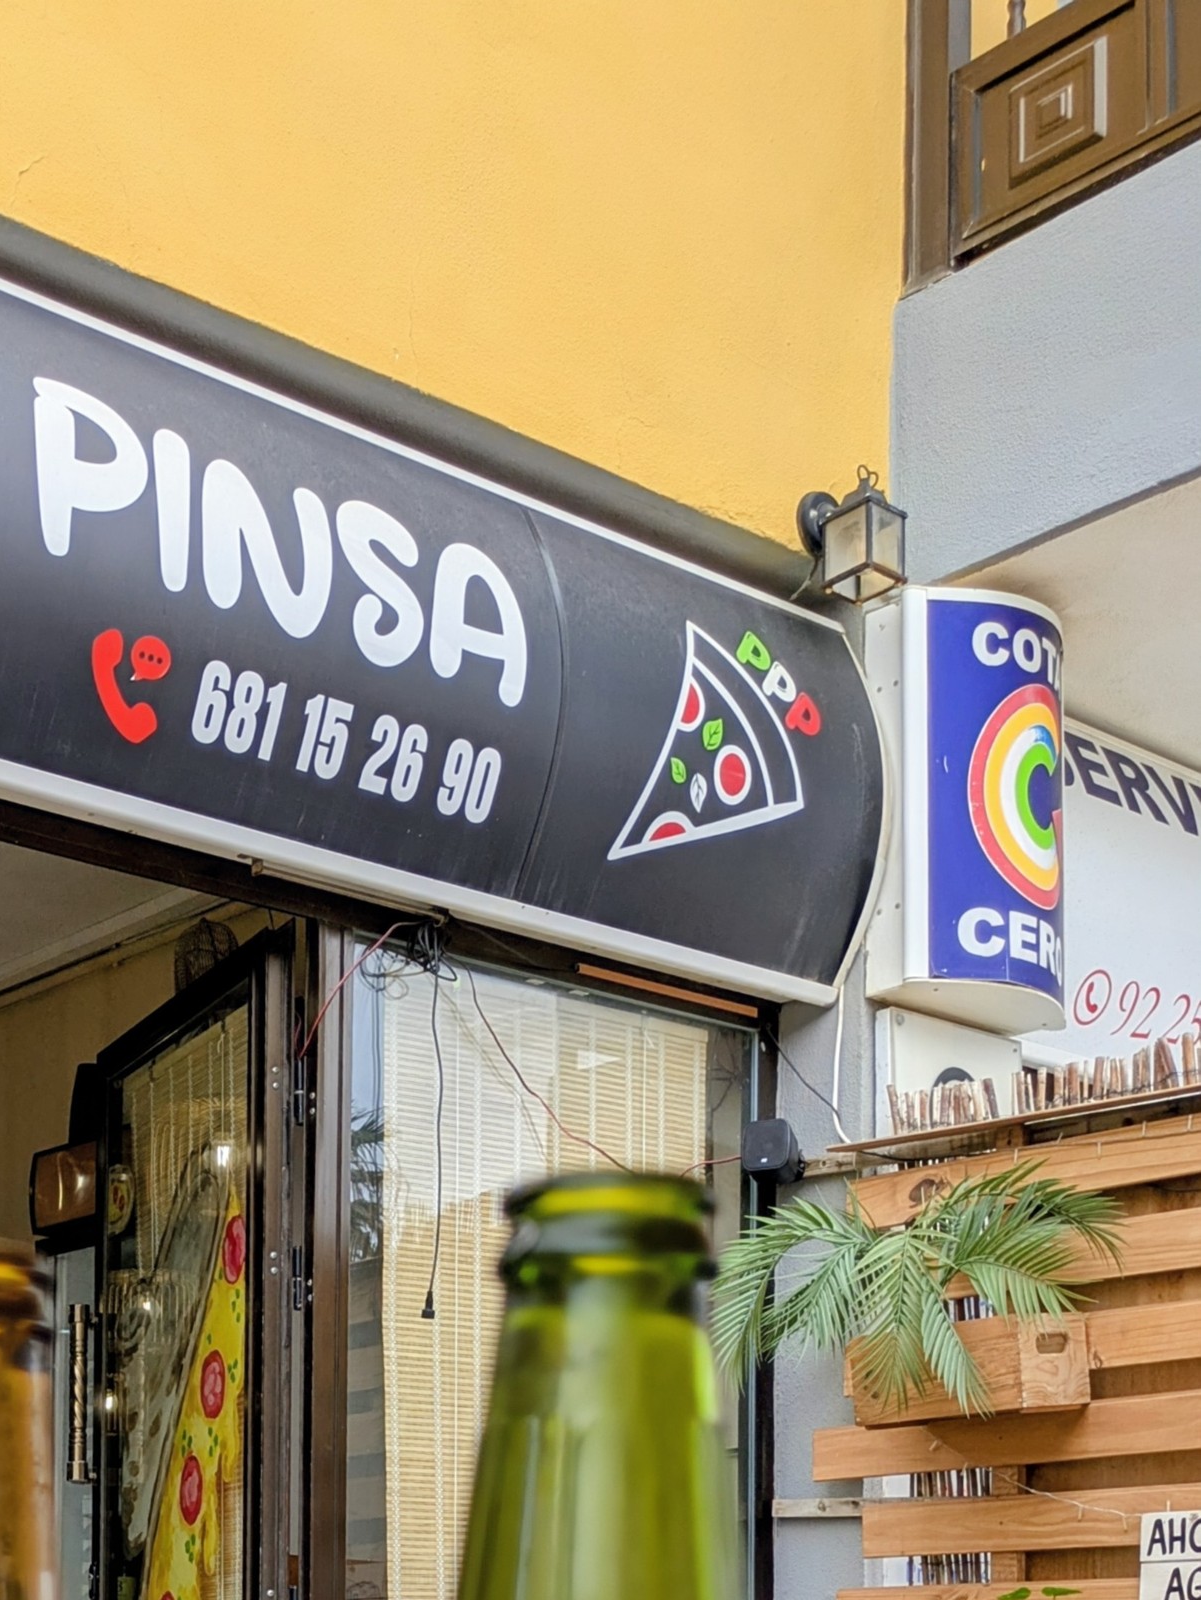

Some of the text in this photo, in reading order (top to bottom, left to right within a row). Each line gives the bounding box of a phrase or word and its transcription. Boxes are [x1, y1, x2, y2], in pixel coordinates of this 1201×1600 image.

[32, 376, 527, 708] PINSA
[191, 660, 502, 824] 681 15 26 90
[1064, 731, 1201, 837] ERV
